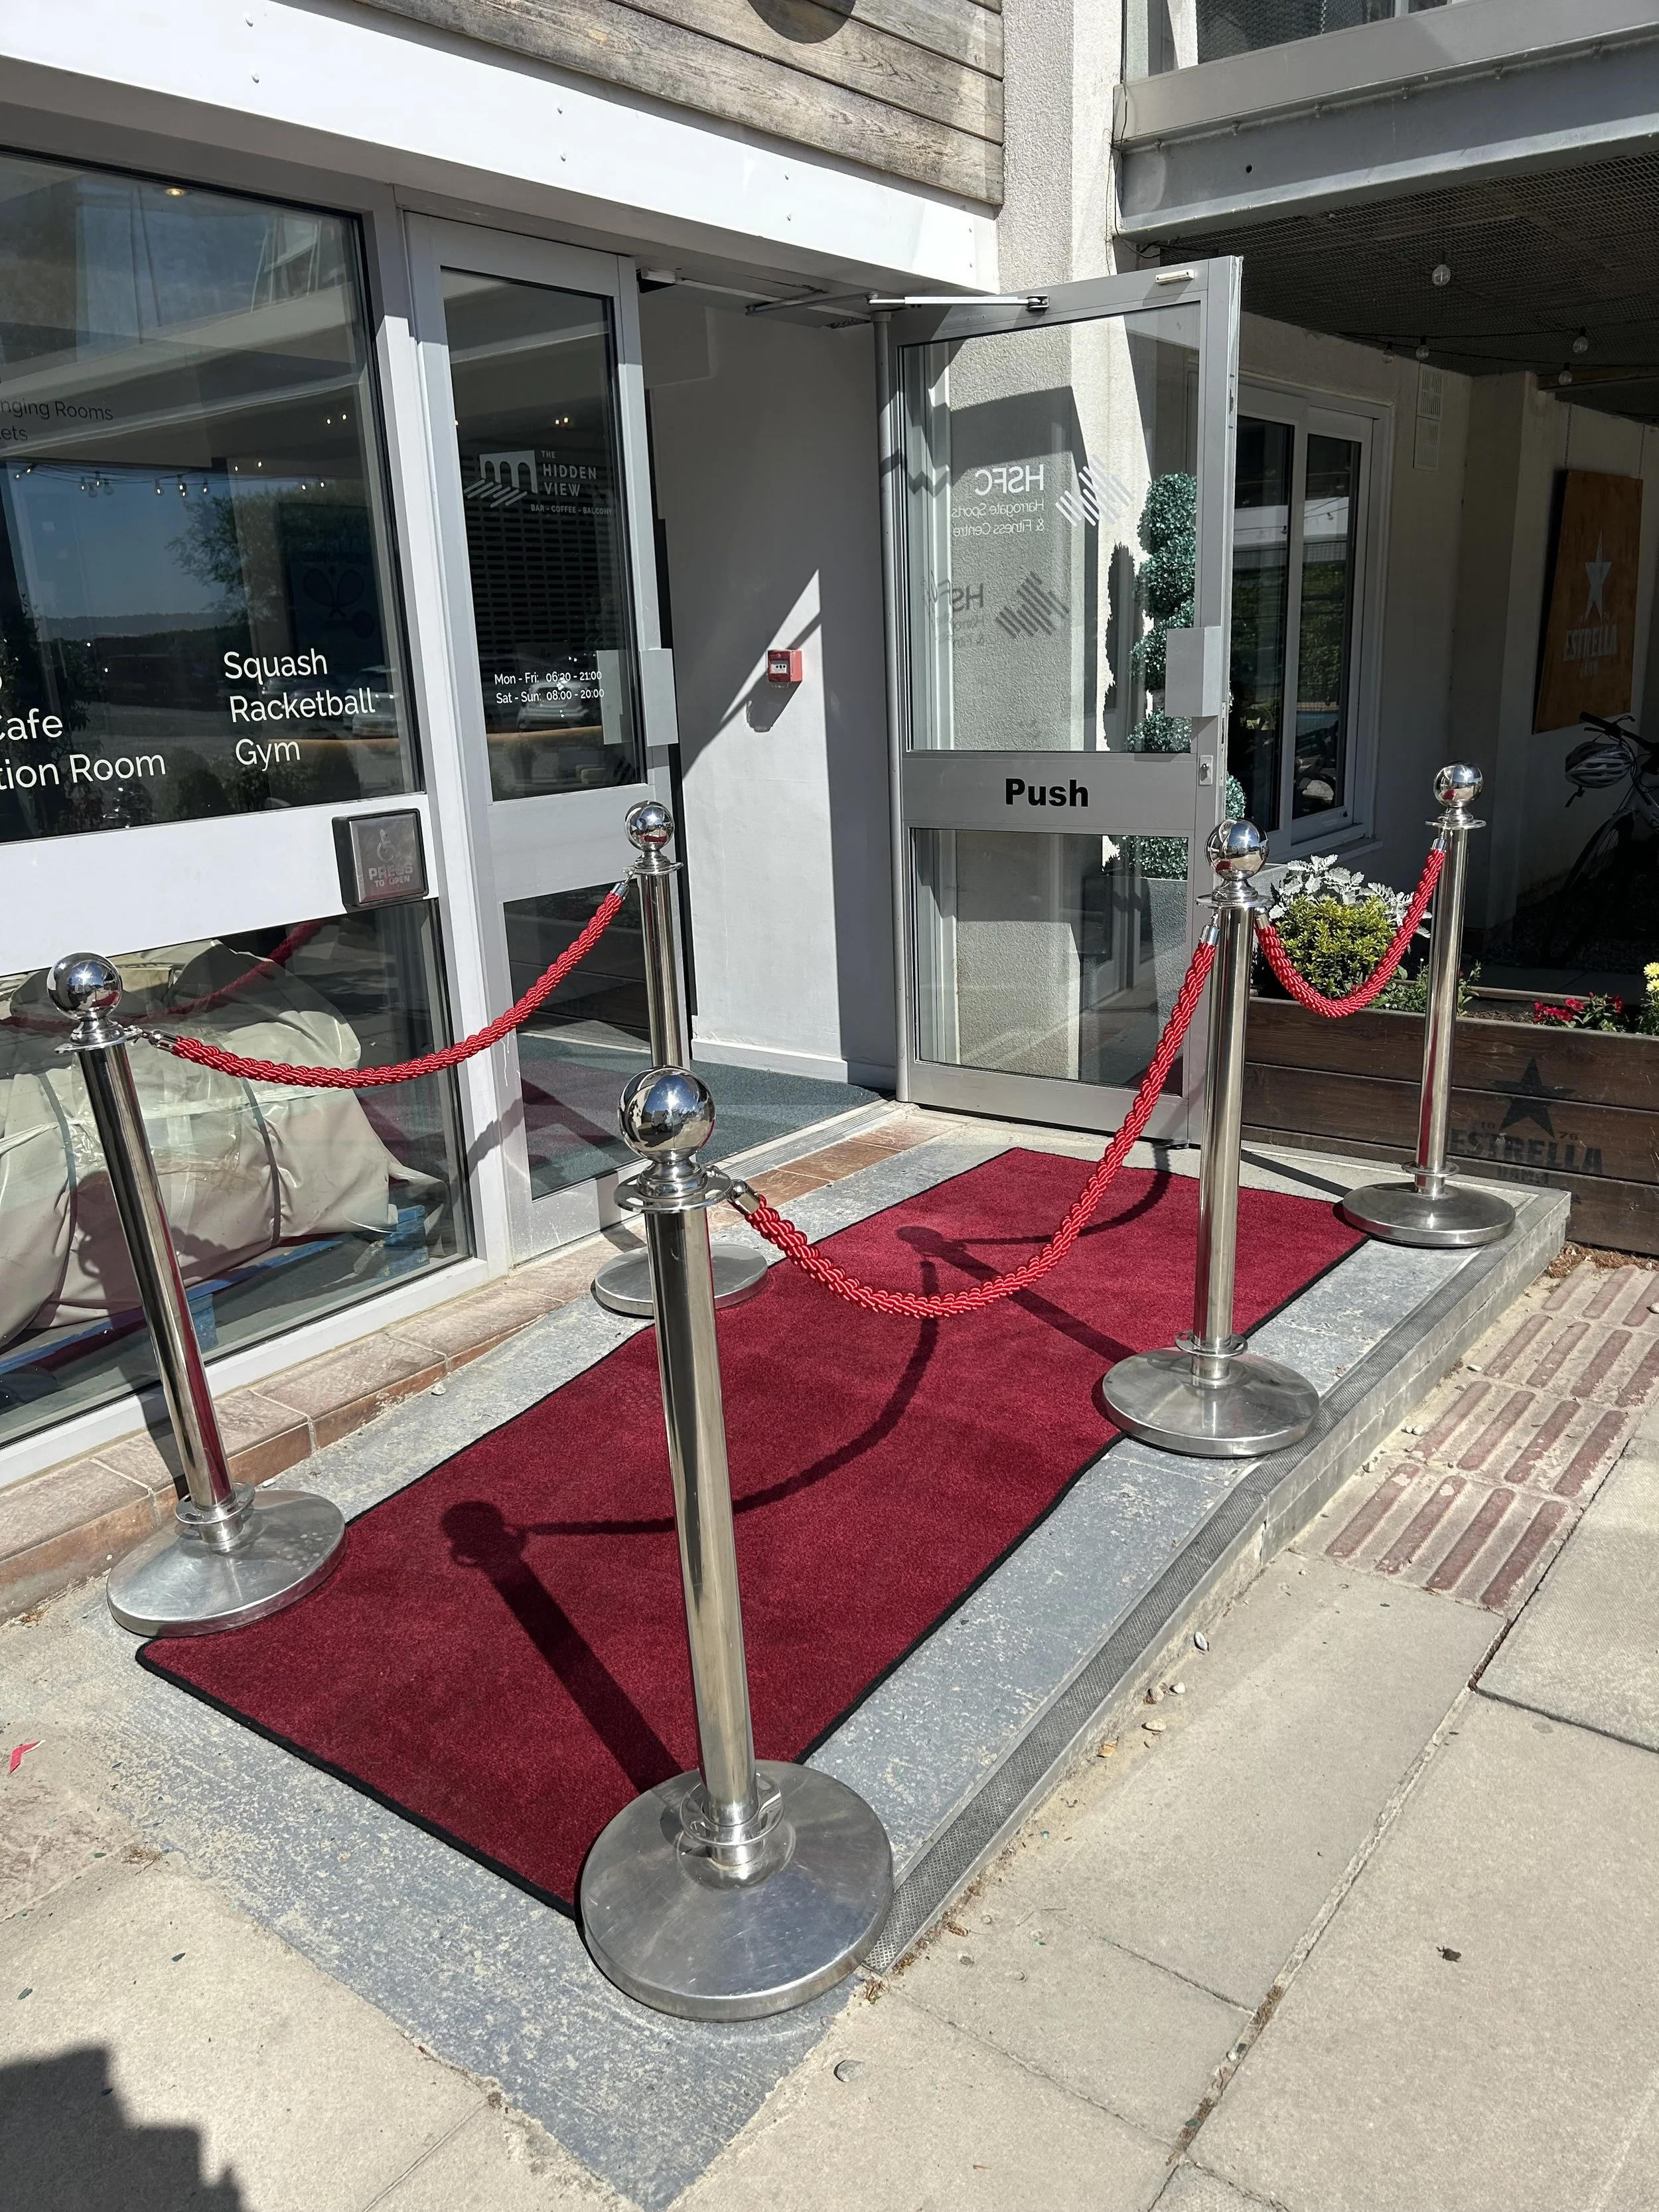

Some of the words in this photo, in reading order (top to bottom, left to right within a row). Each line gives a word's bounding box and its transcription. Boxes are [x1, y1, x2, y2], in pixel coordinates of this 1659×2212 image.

[55, 401, 113, 420] Rooms
[0, 425, 28, 441] ets
[543, 463, 597, 479] HIDDEN
[544, 482, 580, 496] VIEW
[583, 506, 613, 515] BALCONY
[224, 648, 328, 685] Squash
[494, 674, 516, 685] Mon
[525, 672, 540, 683] Fri:
[579, 671, 603, 681] 21:00
[496, 693, 513, 703] Sat
[521, 691, 541, 702] Sun:
[546, 690, 572, 701] 08:00
[581, 688, 605, 699] 20:00
[230, 687, 376, 723] Racketball
[0, 708, 63, 740] afe
[235, 738, 301, 771] Gym
[70, 754, 166, 783] Room
[1005, 778, 1088, 807] Push
[368, 863, 413, 880] PRESS
[389, 875, 410, 885] OPEN
[1449, 1128, 1603, 1174] ESTRELLA
